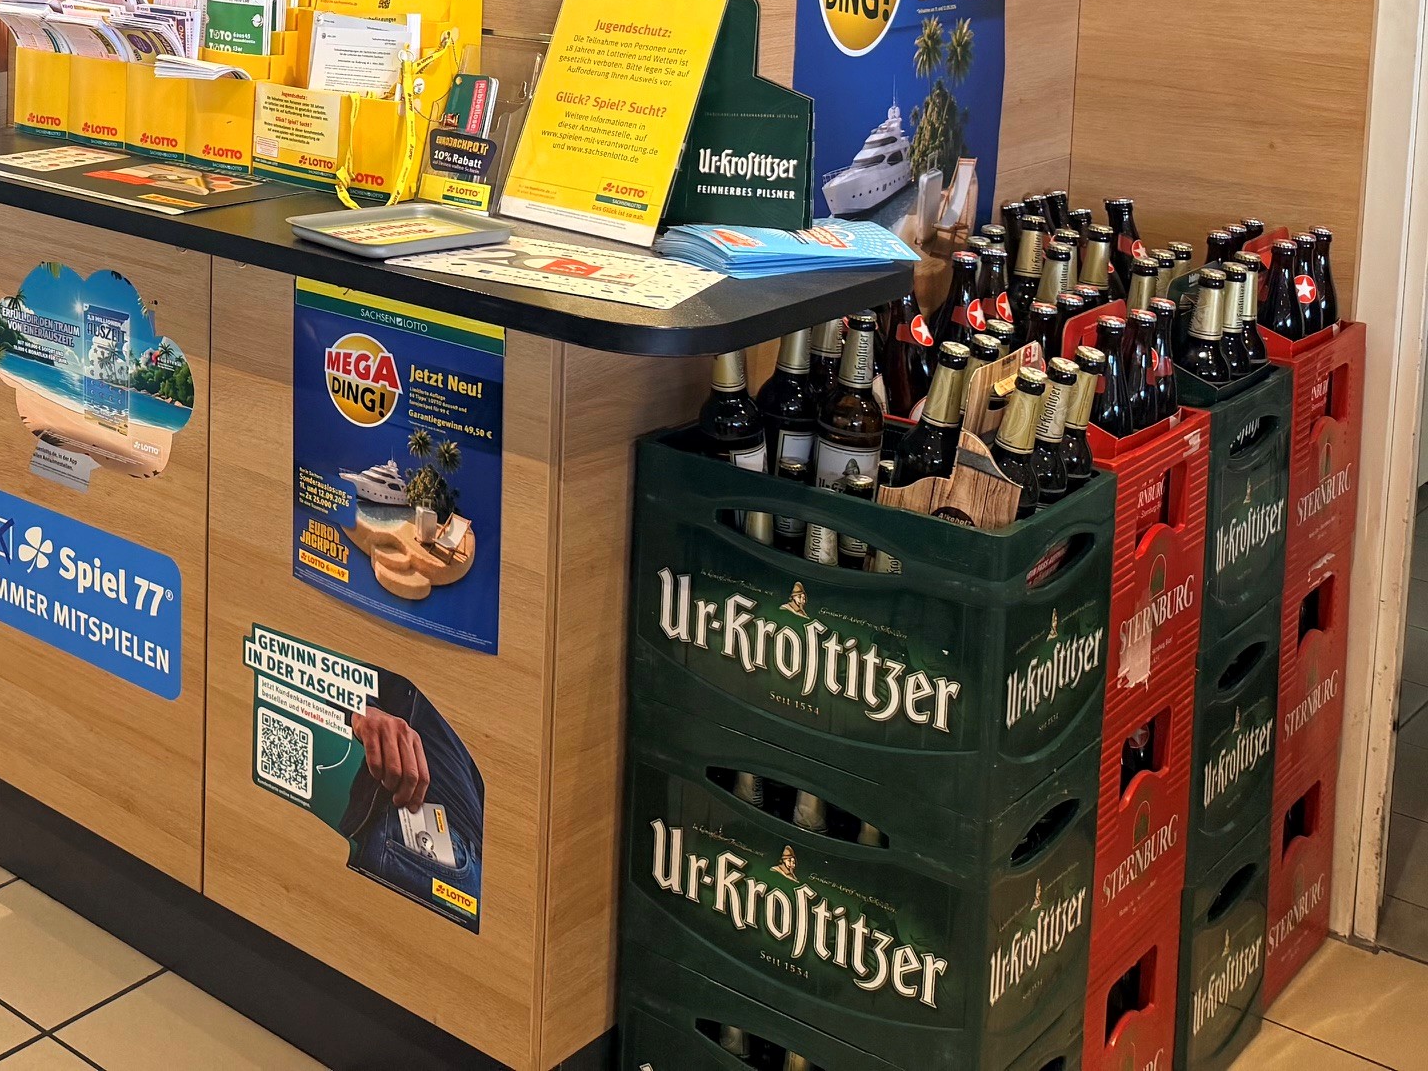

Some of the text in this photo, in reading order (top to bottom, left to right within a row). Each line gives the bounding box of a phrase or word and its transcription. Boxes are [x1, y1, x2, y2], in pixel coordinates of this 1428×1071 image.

[573, 34, 584, 43] Die
[586, 35, 619, 48] Teilnahme
[620, 40, 633, 49] von
[634, 42, 666, 55] Personen
[594, 19, 672, 39] Jugendschutz:
[559, 54, 690, 79] gesetzlich verboten. Bitte legen Sie auf
[574, 45, 595, 55] Jahren
[606, 49, 637, 61] Lotterien
[638, 53, 651, 62] und
[653, 54, 678, 65] Wetten
[679, 59, 689, 67] ist
[567, 65, 609, 79] Aufforderung
[611, 70, 628, 79] Ihren
[629, 73, 658, 85] Ausweis
[36, 114, 61, 127] LOTTO
[556, 91, 667, 118] Glück? Spiel? Sucht?
[564, 110, 646, 130] Weitere Informationen in
[91, 124, 117, 137] LOTTO
[149, 135, 178, 148] LOTTO
[541, 129, 658, 156] www.spielen-mit-verantwortung.de
[558, 120, 647, 142] dieser Annahmestelle, auf
[212, 147, 243, 160] LOTTO
[308, 157, 334, 169] LOTTO
[434, 150, 482, 169] 10% Rabatt
[552, 142, 639, 164] und www.sachsenlotto.de
[699, 148, 798, 181] Ur-Krostitzer
[455, 186, 478, 197] LOTTO
[615, 185, 645, 198] LOTTO
[697, 184, 796, 200] FEINHERBES PILSNER
[325, 351, 400, 391] MEGA
[409, 364, 482, 398] Jetzt Neu!
[332, 376, 387, 418] DING!
[1297, 463, 1352, 526] STERNBURG
[1215, 497, 1284, 574] Ur-Krostitzer
[59, 546, 128, 605] Spiel
[1119, 574, 1195, 655] STERNBURG
[54, 600, 170, 674] MITSPIELEN
[657, 567, 961, 733] Ur-Krostitzer
[248, 645, 363, 711] IN DER TASCHE?
[258, 633, 374, 690] GEWINN SCHON
[1005, 624, 1104, 731] Ur-Krostitzer
[262, 680, 342, 722] Jetzt Kundenkarte kostenfrei
[1283, 670, 1339, 743] STERNBURG
[1203, 717, 1273, 810] Ur-Krostitzer
[1101, 815, 1179, 908] STERNBURG
[446, 887, 472, 908] LOTTO
[650, 818, 950, 1009] Ur-Krostitzer
[1267, 873, 1325, 957] STERNBURG
[989, 886, 1087, 1008] Ur-Krostitzer
[1192, 935, 1263, 1037] Ur-Krostitzer
